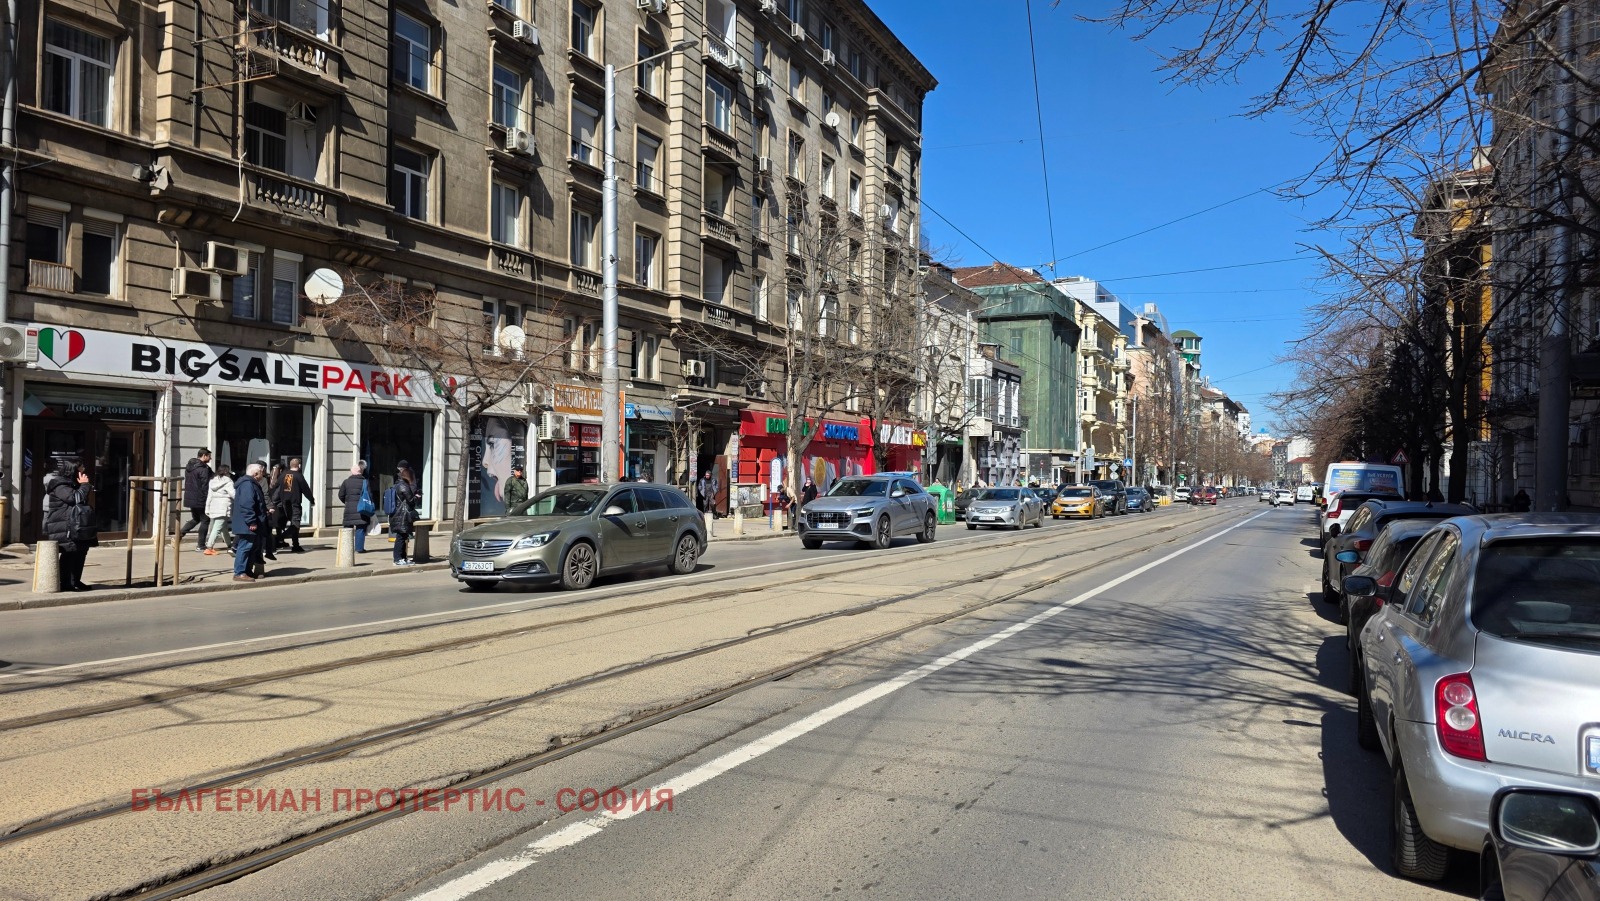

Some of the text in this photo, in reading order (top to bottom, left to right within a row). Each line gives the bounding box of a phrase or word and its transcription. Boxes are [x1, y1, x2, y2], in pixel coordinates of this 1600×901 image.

[132, 343, 210, 378] BIG
[65, 402, 142, 416] Добре дошли
[1498, 728, 1556, 744] MICRA
